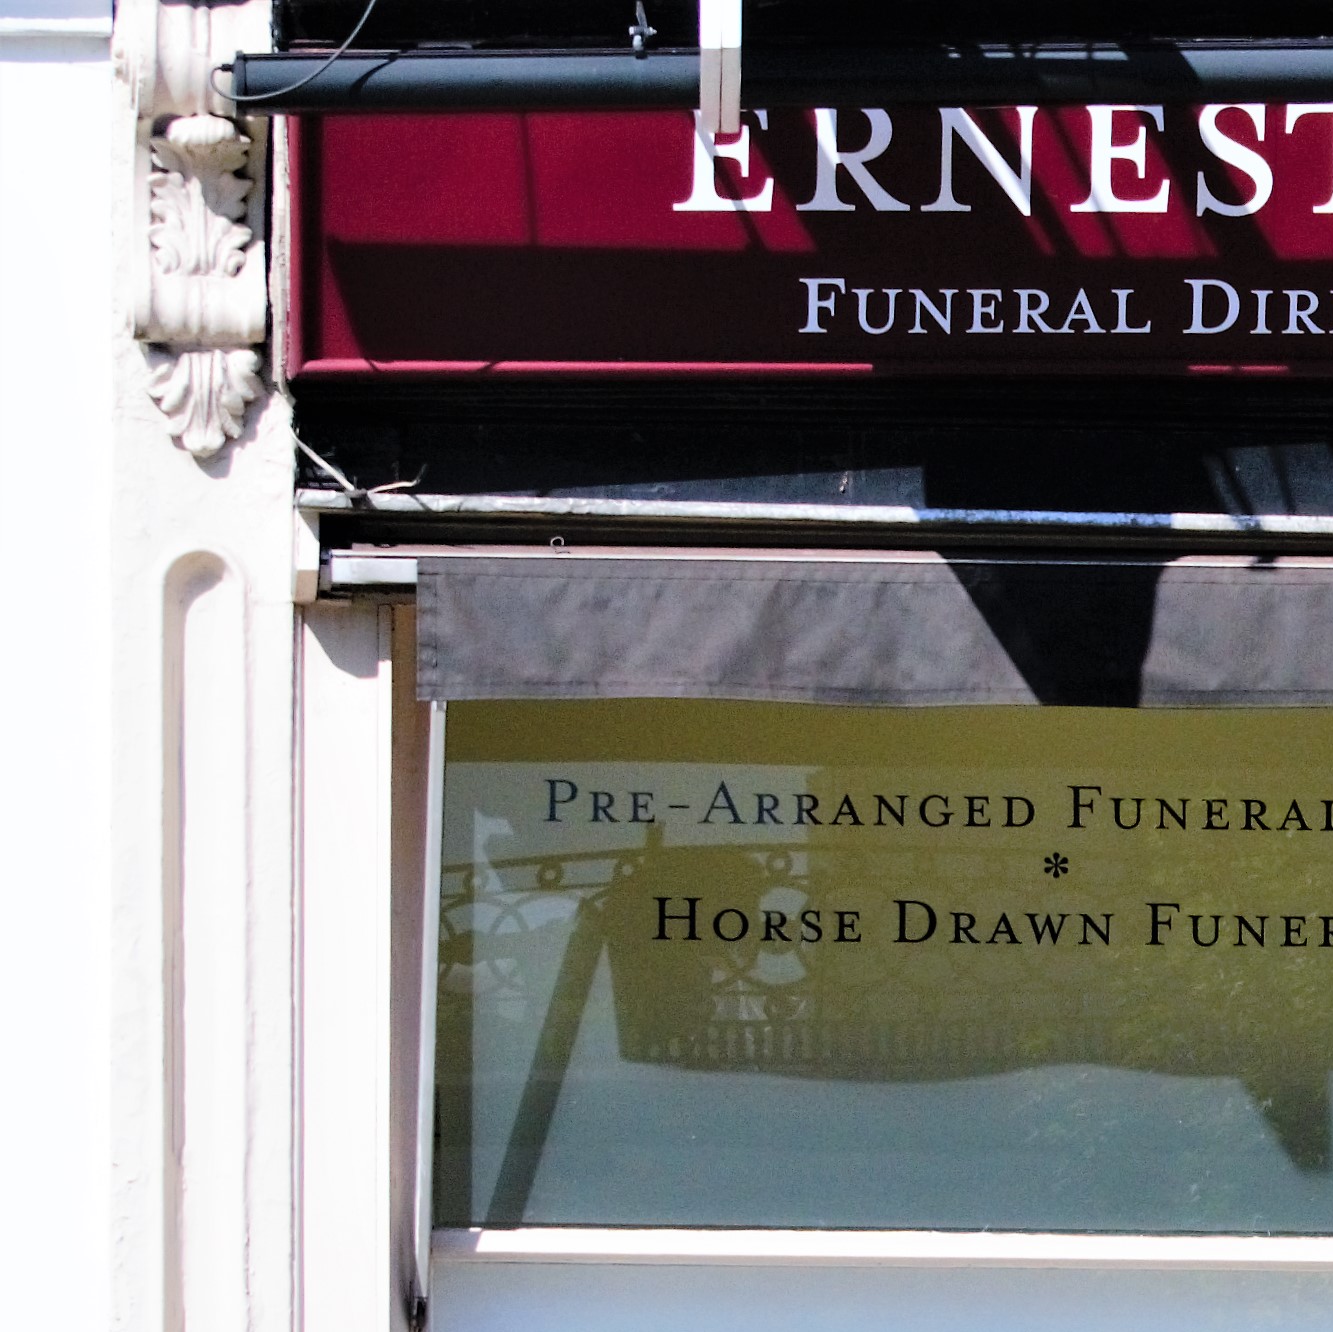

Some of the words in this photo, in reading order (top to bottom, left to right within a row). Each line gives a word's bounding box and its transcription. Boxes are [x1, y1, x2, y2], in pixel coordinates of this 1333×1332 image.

[798, 277, 1152, 335] FUNERAL
[546, 778, 1036, 828] PRE-ARRANGED
[652, 896, 863, 944] HORSE
[893, 899, 1114, 947] DRAWN
